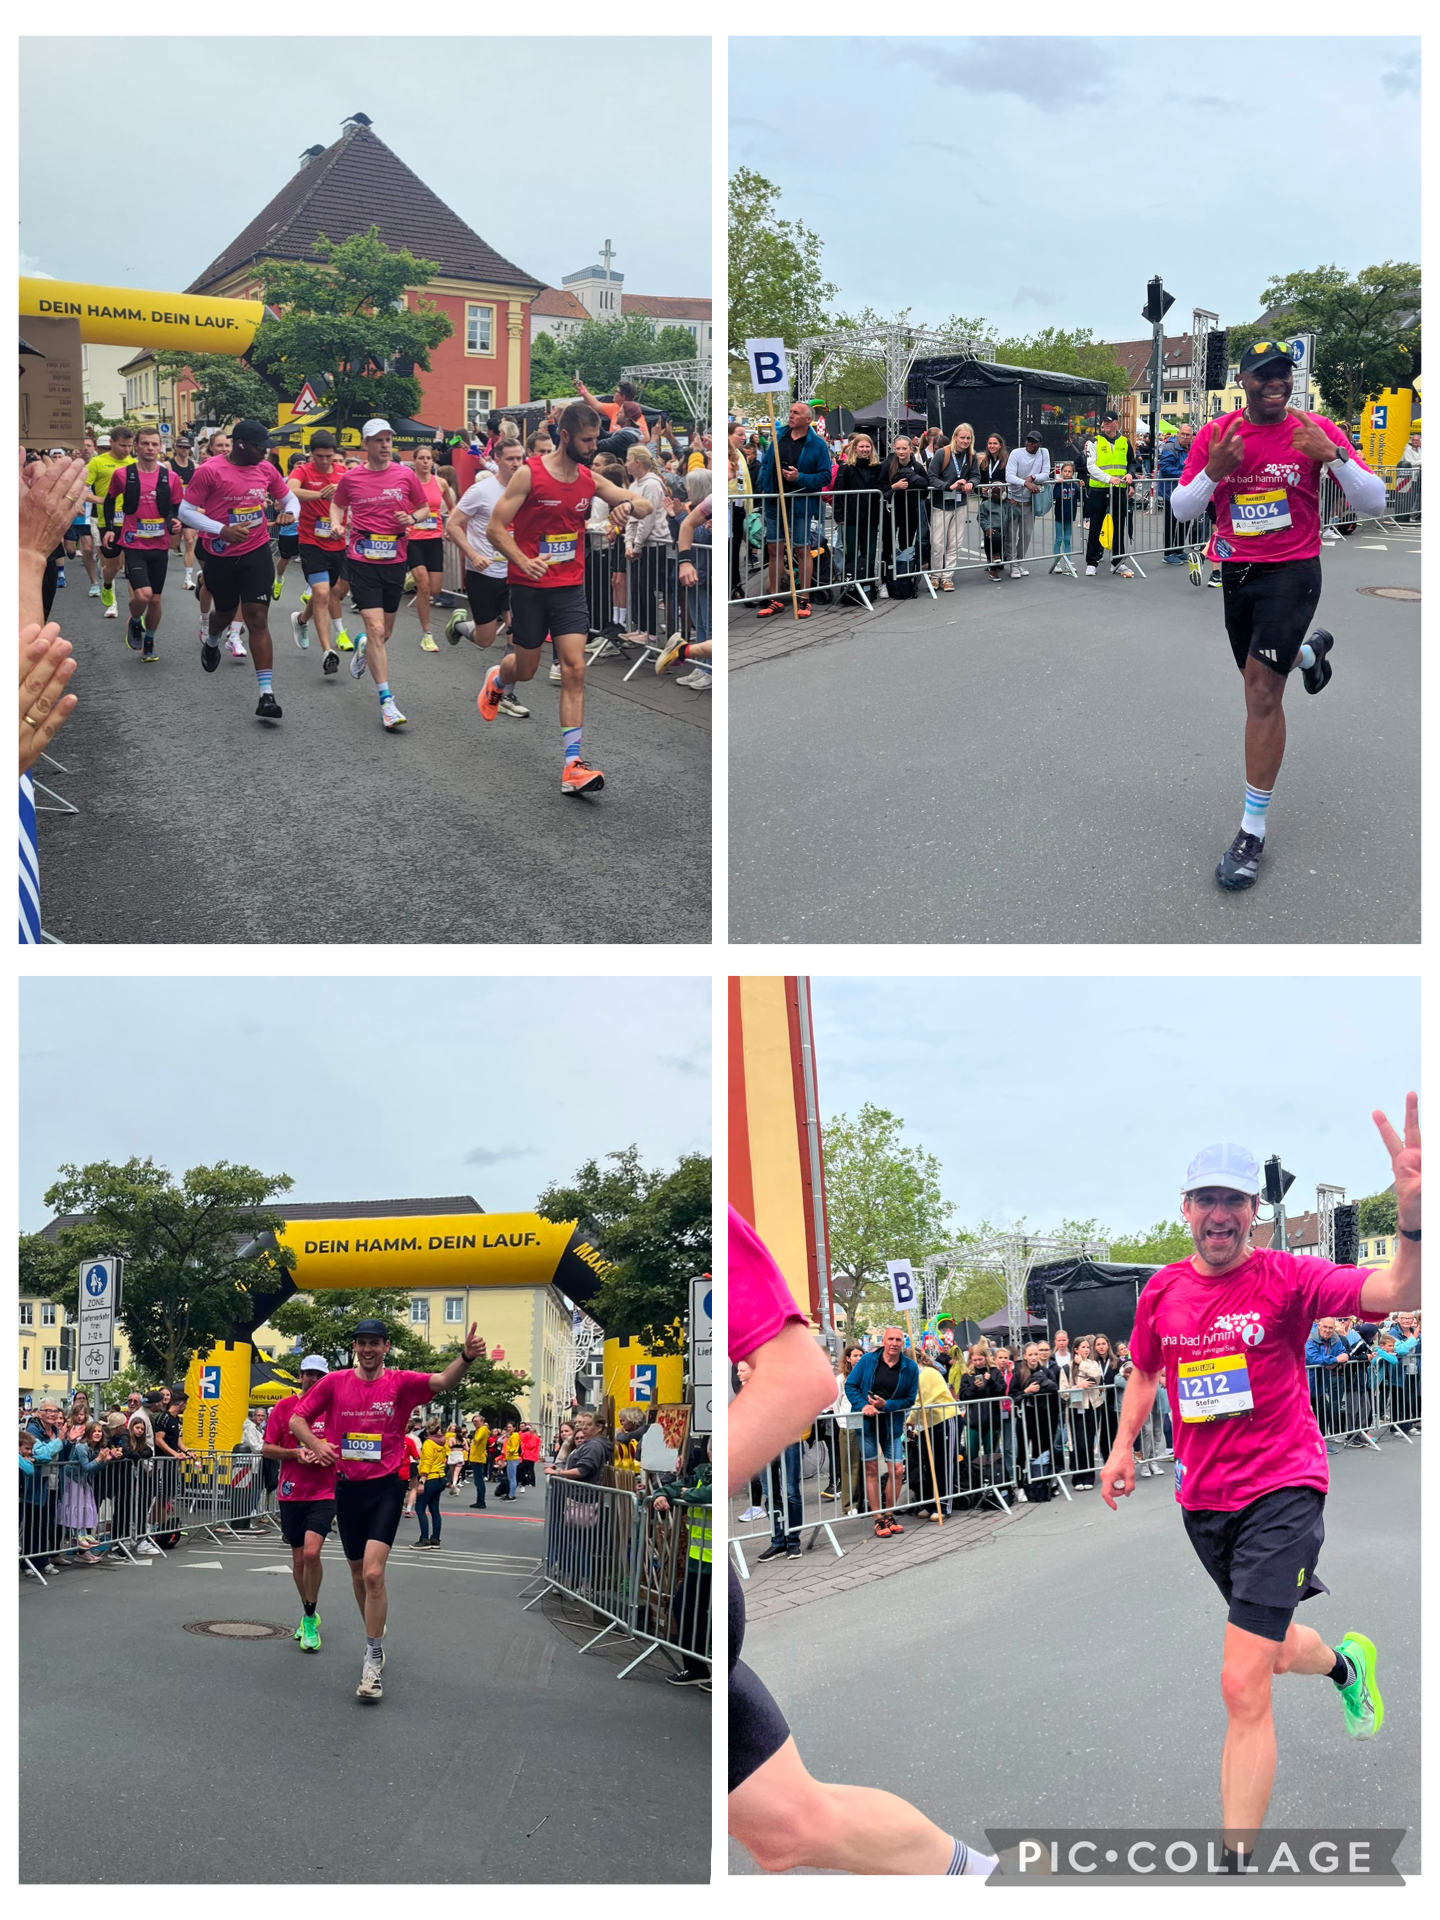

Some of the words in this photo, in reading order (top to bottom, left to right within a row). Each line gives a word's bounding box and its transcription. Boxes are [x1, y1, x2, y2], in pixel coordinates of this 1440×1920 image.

[39, 299, 82, 315] DEIN
[88, 304, 146, 322] HAMM.
[152, 310, 190, 325] DEIN
[195, 314, 239, 330] LAUF.
[754, 352, 783, 384] B
[1266, 464, 1278, 472] 20
[1237, 475, 1253, 484] bad
[1256, 475, 1283, 483] hamm
[1238, 503, 1279, 519] 1004
[235, 513, 258, 522] 1004
[371, 541, 394, 550] 1007
[548, 542, 571, 553] 1363
[304, 1240, 349, 1254] DEIN
[356, 1237, 422, 1252] HAMM.
[428, 1235, 476, 1250] DEIN
[483, 1232, 541, 1248] LAUF.
[894, 1272, 914, 1303] B
[87, 1298, 105, 1308] ZONE
[90, 1322, 101, 1330] frei
[1180, 1334, 1200, 1346] bad
[89, 1368, 100, 1376] frei
[1182, 1374, 1230, 1398] 1212
[1196, 1398, 1219, 1407] Stefan
[198, 1405, 206, 1438] Hamm
[348, 1441, 375, 1450] 1009
